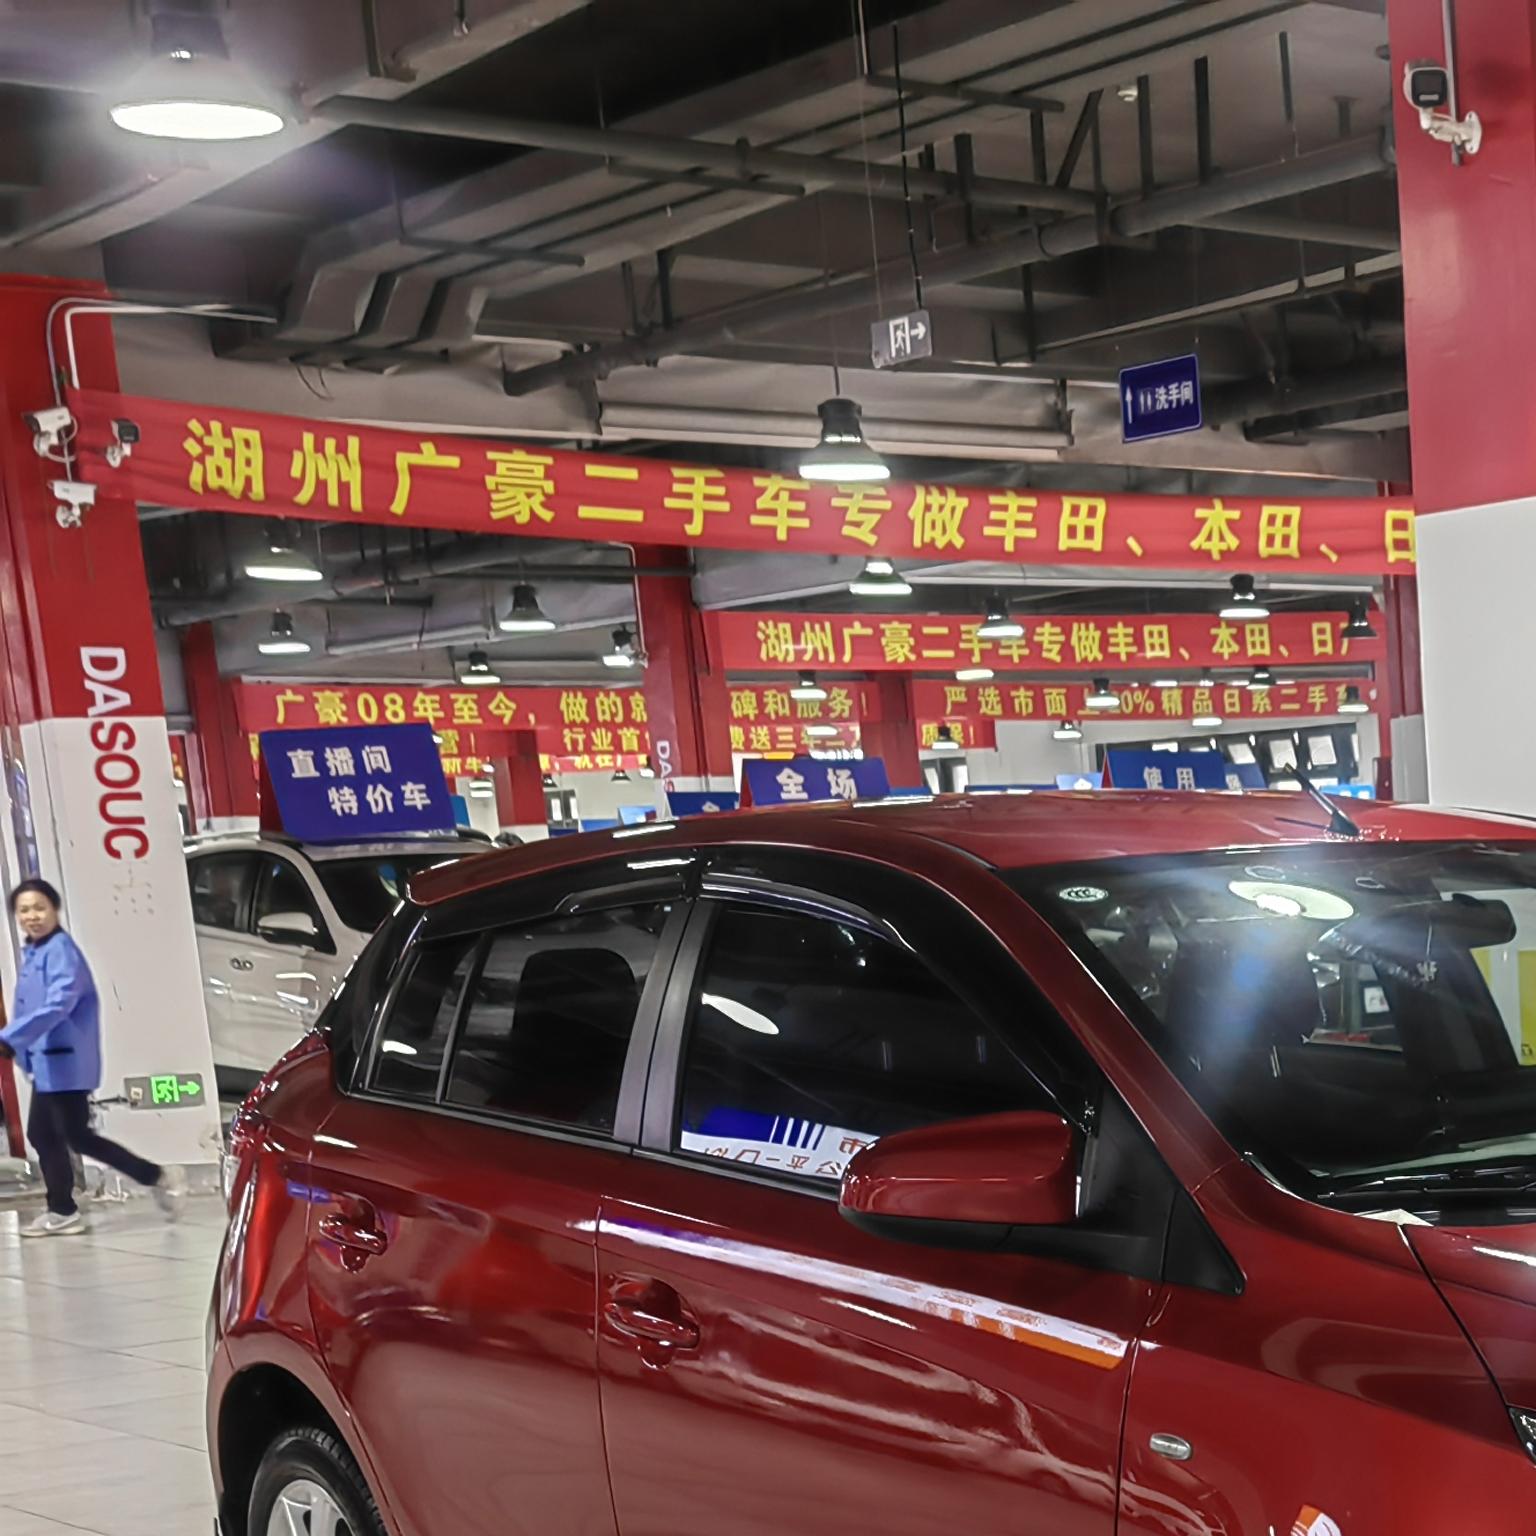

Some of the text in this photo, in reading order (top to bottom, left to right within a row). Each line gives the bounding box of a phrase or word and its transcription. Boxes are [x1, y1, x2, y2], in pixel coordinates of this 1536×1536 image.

[1155, 381, 1194, 410] 洗手间
[80, 646, 150, 860] DASOUC
[563, 726, 651, 753] 行业首
[286, 745, 393, 779] 直播间
[327, 782, 432, 817] 特价车
[776, 767, 857, 801] 全场
